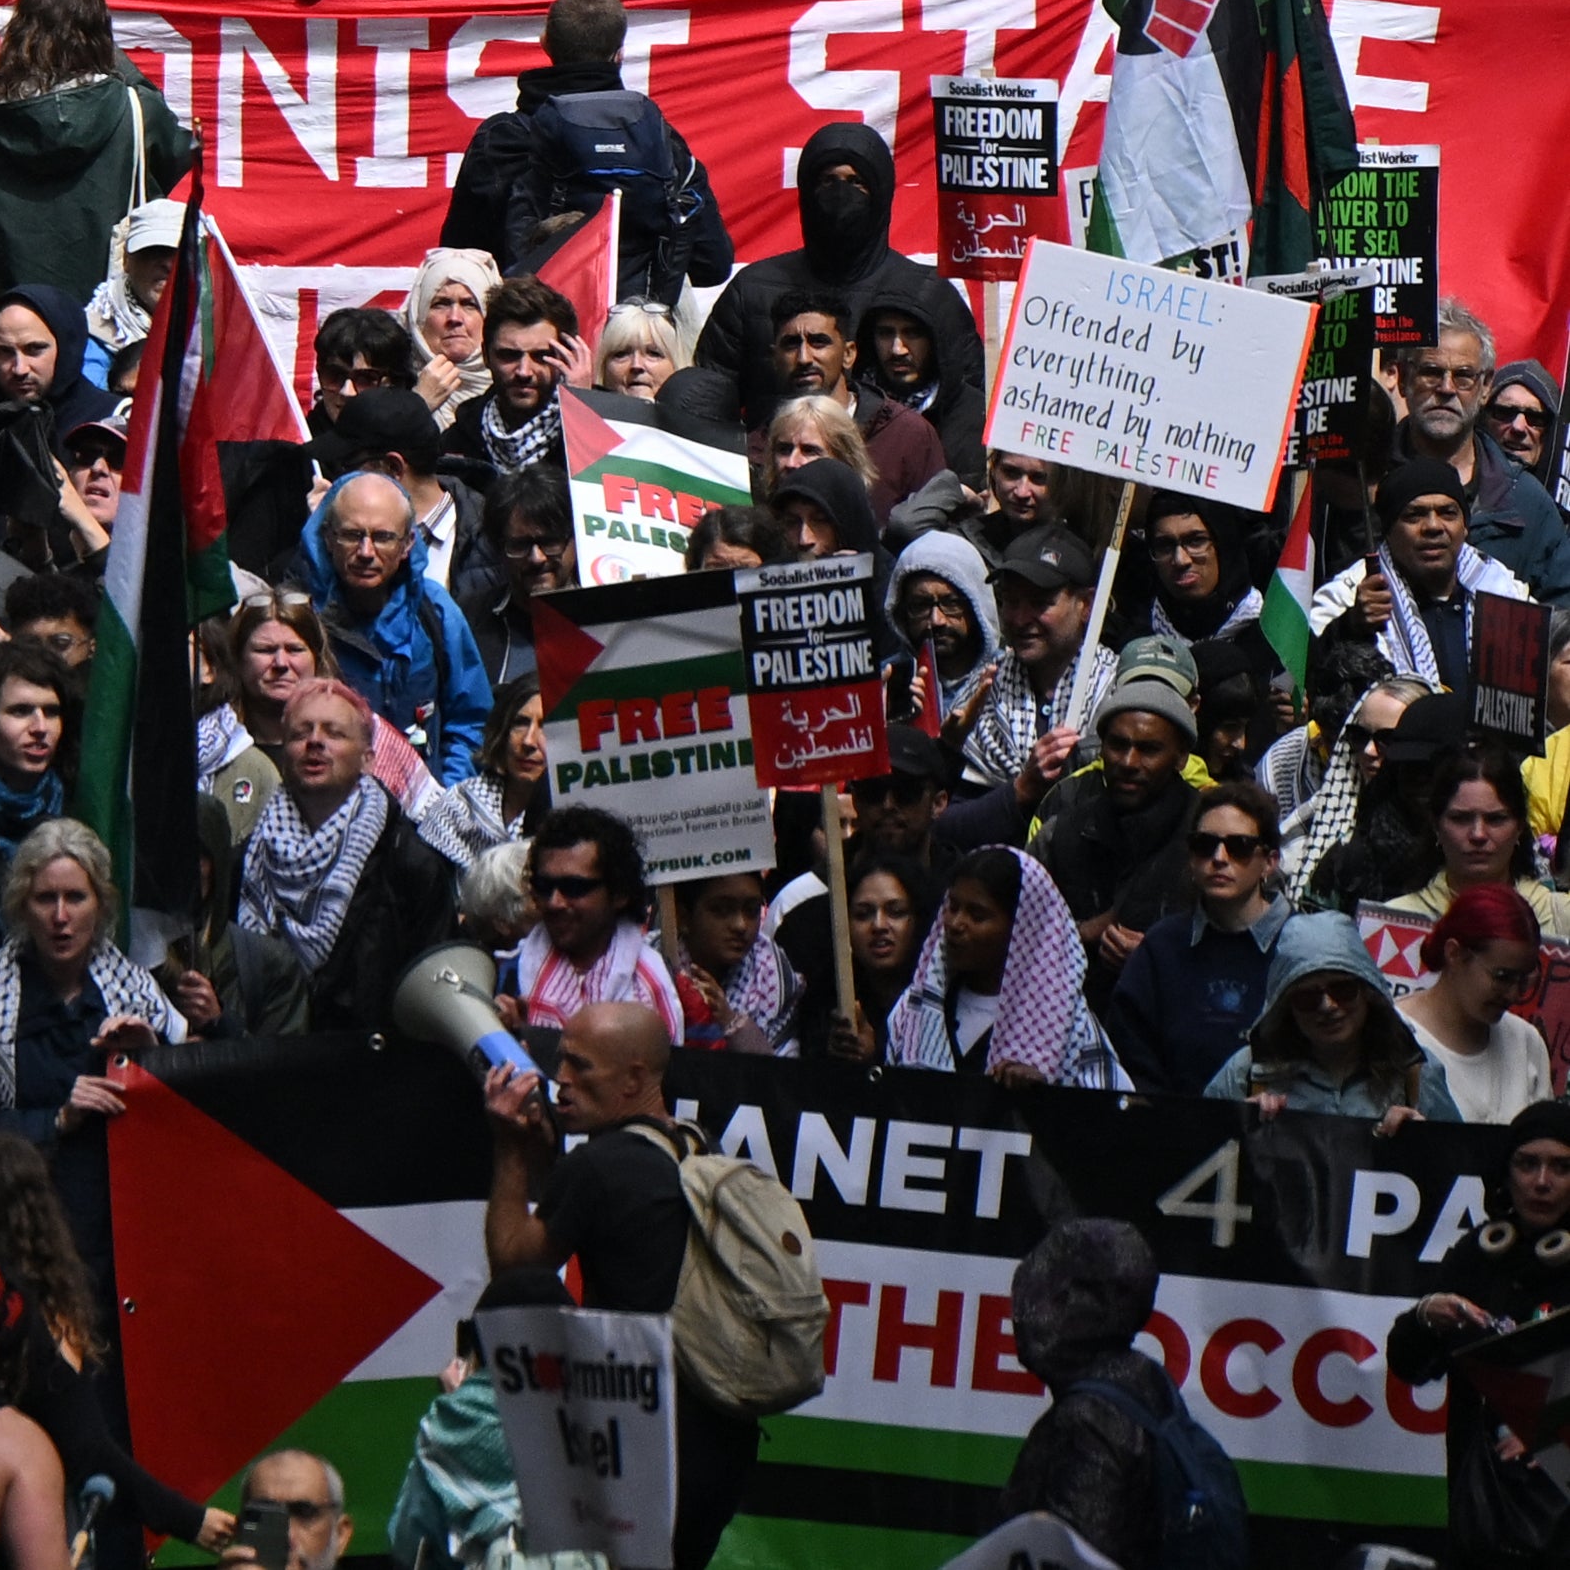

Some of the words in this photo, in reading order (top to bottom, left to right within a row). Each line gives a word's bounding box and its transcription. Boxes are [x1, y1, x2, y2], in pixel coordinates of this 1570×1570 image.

[949, 82, 993, 97] Socialist
[994, 85, 1037, 98] Worker
[944, 105, 1043, 140] FREEDOM
[941, 153, 1049, 189] PALESTINE
[957, 200, 1027, 233] الحرية
[1105, 269, 1225, 328] ISRAEL:
[1024, 295, 1152, 353] Offended
[1171, 328, 1206, 375] by
[1002, 380, 1115, 431] ashamed
[1123, 403, 1152, 448] by
[1164, 421, 1257, 473] nothing
[1020, 421, 1075, 455] FREE
[1095, 439, 1221, 490] PALESTINE
[759, 566, 813, 587] Socialist
[814, 563, 856, 581] Worker
[754, 587, 865, 632] FREEDOM
[753, 639, 874, 687] PALESTINE
[576, 686, 734, 754] FREE
[781, 692, 862, 733] الحرية
[776, 726, 874, 770] لفلسطين
[1157, 1139, 1254, 1249] 4
